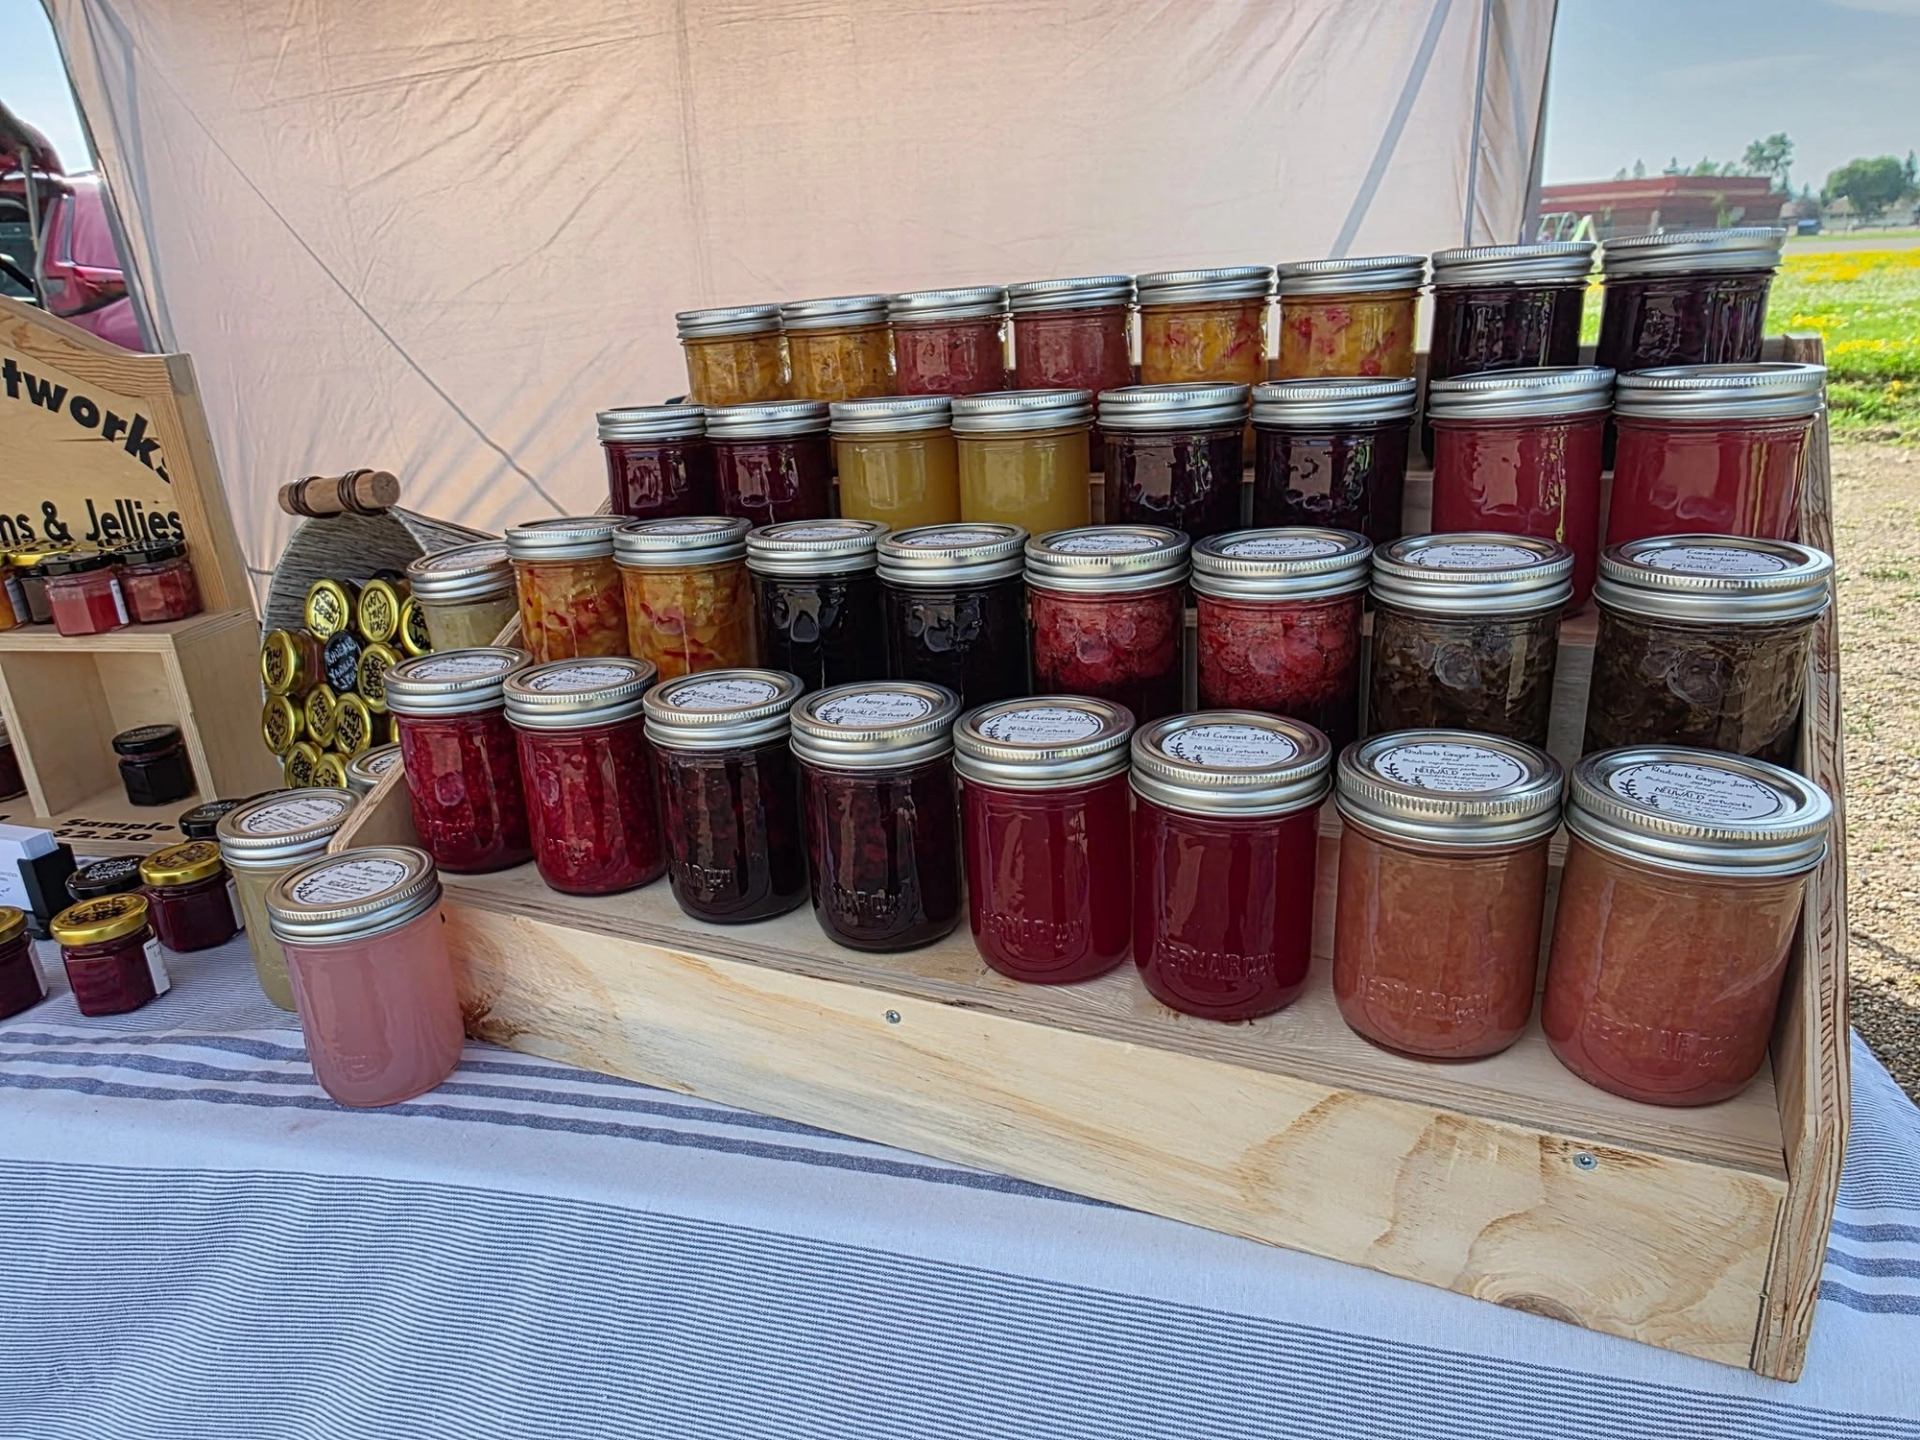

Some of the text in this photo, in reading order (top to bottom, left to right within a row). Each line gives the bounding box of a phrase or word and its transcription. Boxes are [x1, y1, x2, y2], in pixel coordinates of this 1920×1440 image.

[42, 501, 75, 542] &
[86, 499, 184, 543] Jellies
[856, 697, 913, 707] Cherry Jam
[1009, 713, 1029, 721] Red
[1190, 730, 1210, 738] Red
[1213, 732, 1248, 740] Currant
[1249, 733, 1275, 743] Jelly
[1404, 748, 1494, 760] Rhubarb Ginger Jam
[1414, 767, 1460, 776] NEUWALD
[1651, 765, 1754, 789] Rhubarb Ginger Jam
[1654, 786, 1706, 801] NEUWALD
[1707, 798, 1753, 809] artworks
[61, 818, 176, 832] Sample
[53, 829, 153, 841] $2.50
